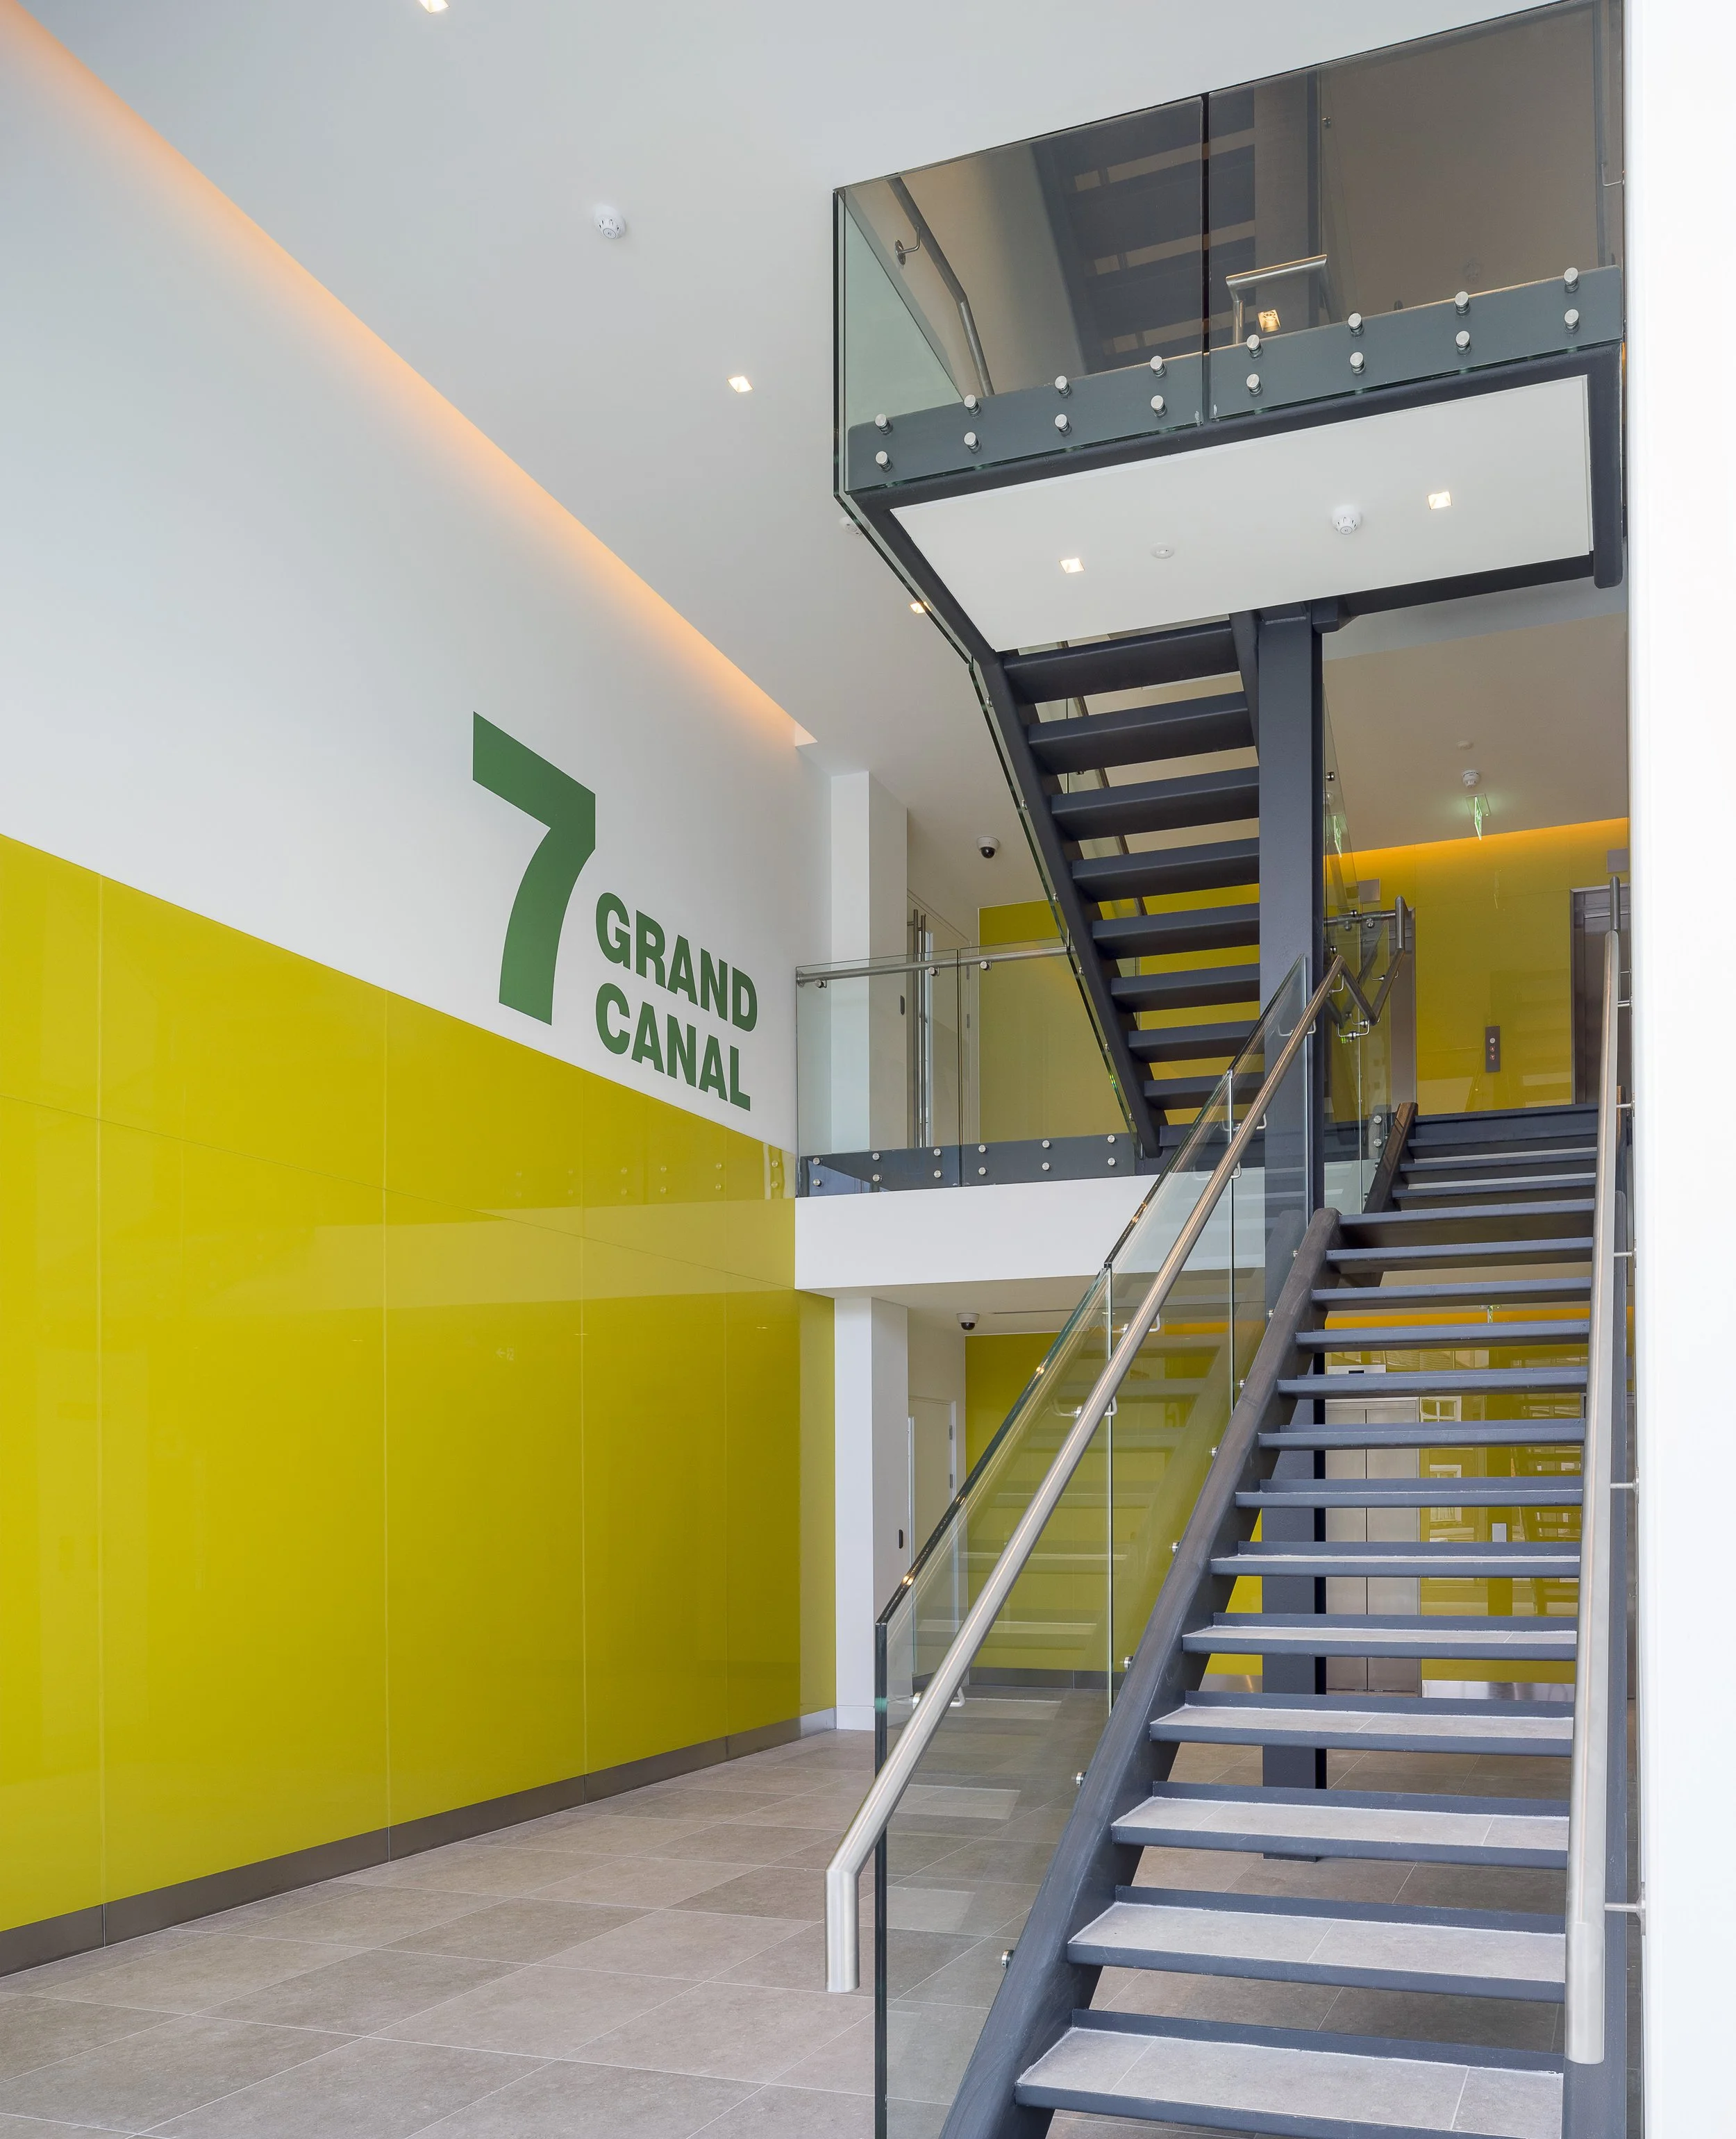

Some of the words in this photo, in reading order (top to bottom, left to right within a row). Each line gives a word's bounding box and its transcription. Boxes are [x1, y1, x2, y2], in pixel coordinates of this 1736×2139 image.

[473, 712, 596, 1025] 7
[596, 893, 758, 1031] GRAND
[596, 983, 751, 1110] CANAL
